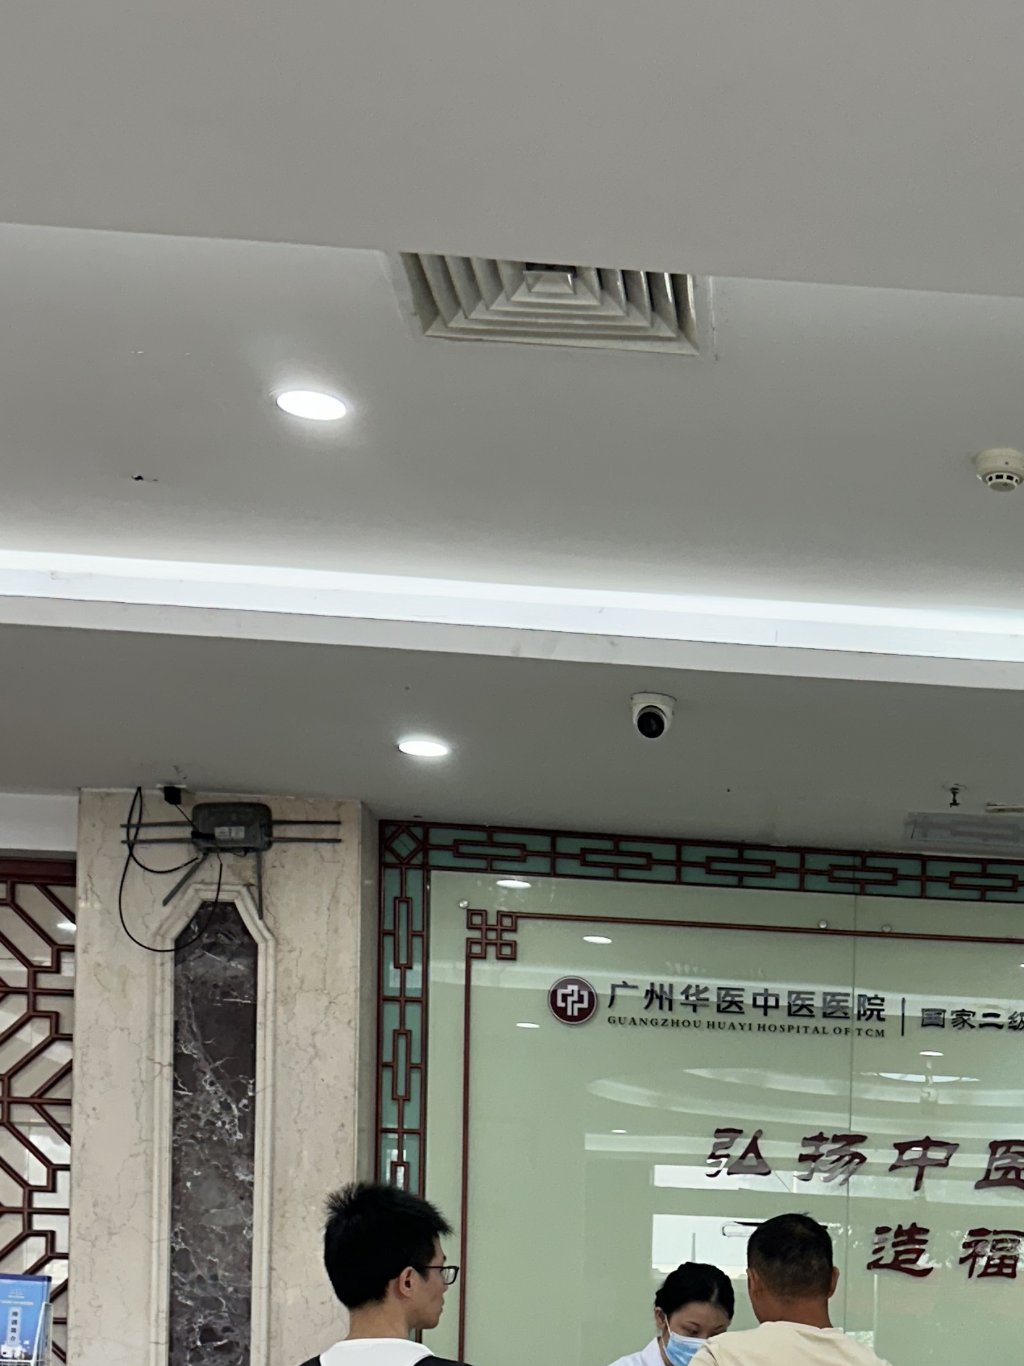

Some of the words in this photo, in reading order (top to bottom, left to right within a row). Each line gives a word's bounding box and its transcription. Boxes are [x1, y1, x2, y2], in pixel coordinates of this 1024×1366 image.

[607, 980, 886, 1022] 广州华医中医医院
[607, 1015, 701, 1029] GUANGZHOU
[706, 1019, 752, 1031] HUAYI
[757, 1022, 828, 1035] HOSPITAL
[833, 1026, 850, 1035] OF
[855, 1027, 886, 1038] TCM
